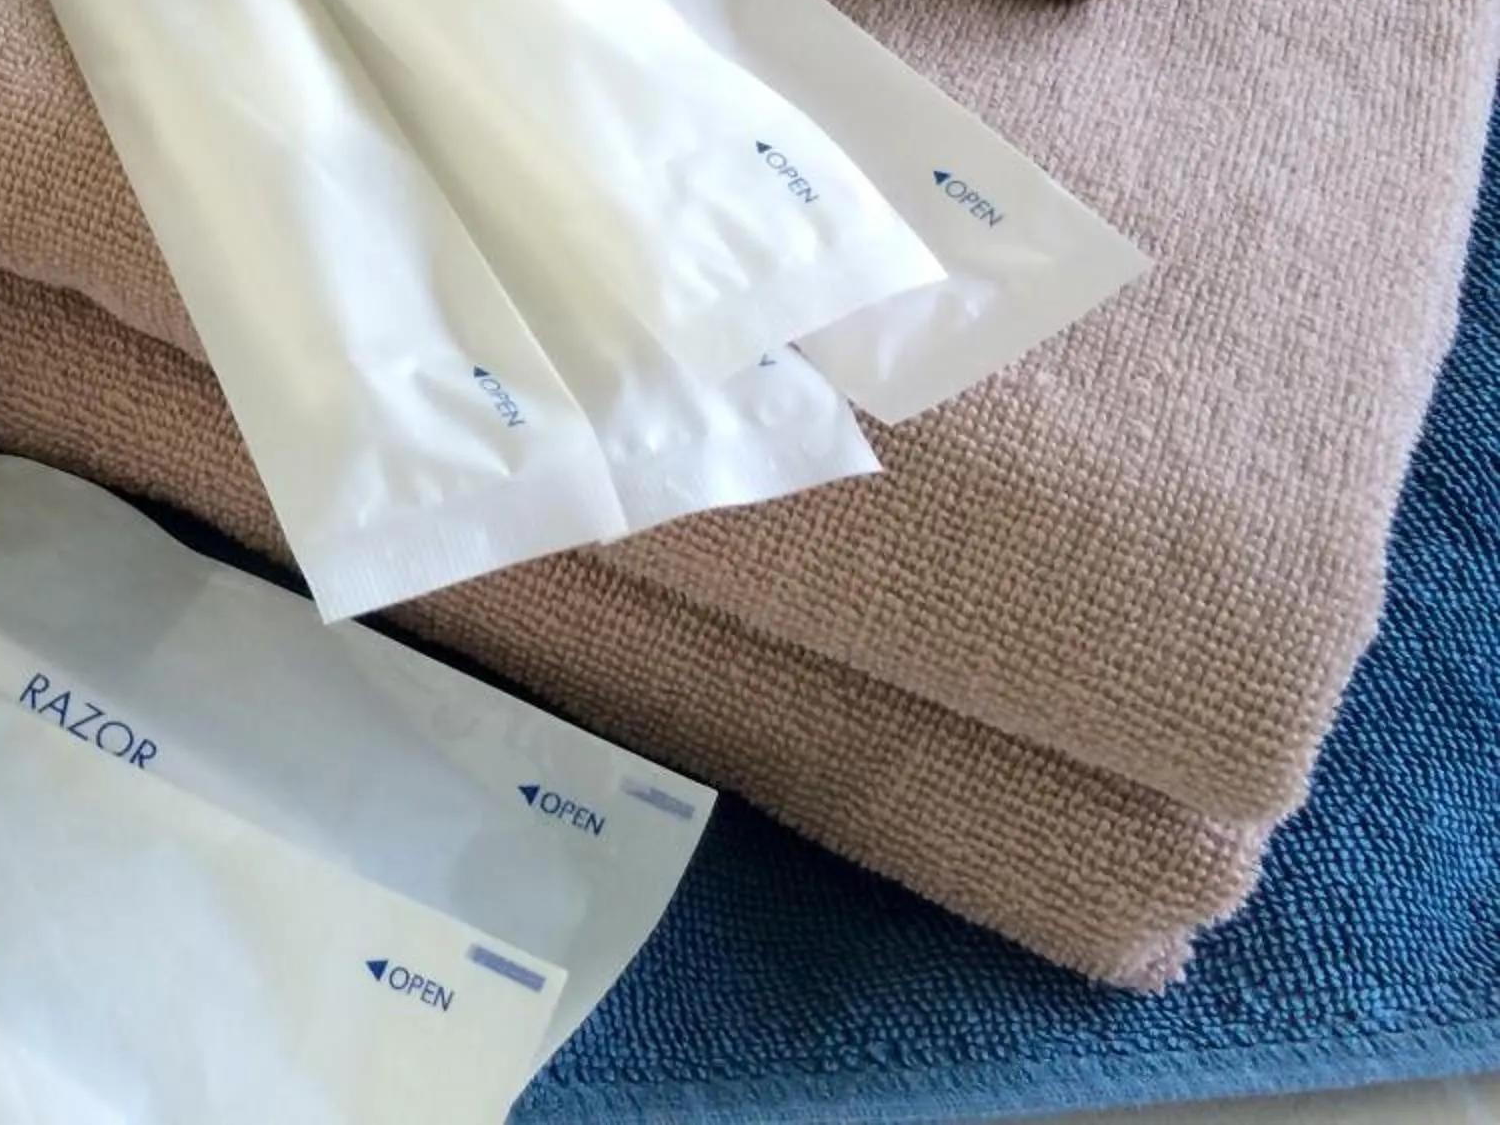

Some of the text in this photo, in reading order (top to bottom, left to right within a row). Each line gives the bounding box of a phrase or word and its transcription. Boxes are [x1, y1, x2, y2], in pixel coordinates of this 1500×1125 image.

[765, 152, 820, 204] OPEN
[945, 180, 1005, 228] OPEN
[479, 378, 526, 428] OPEN
[19, 672, 158, 770] RAZOR
[539, 791, 606, 837] OPEN
[388, 966, 456, 1013] OPEN
